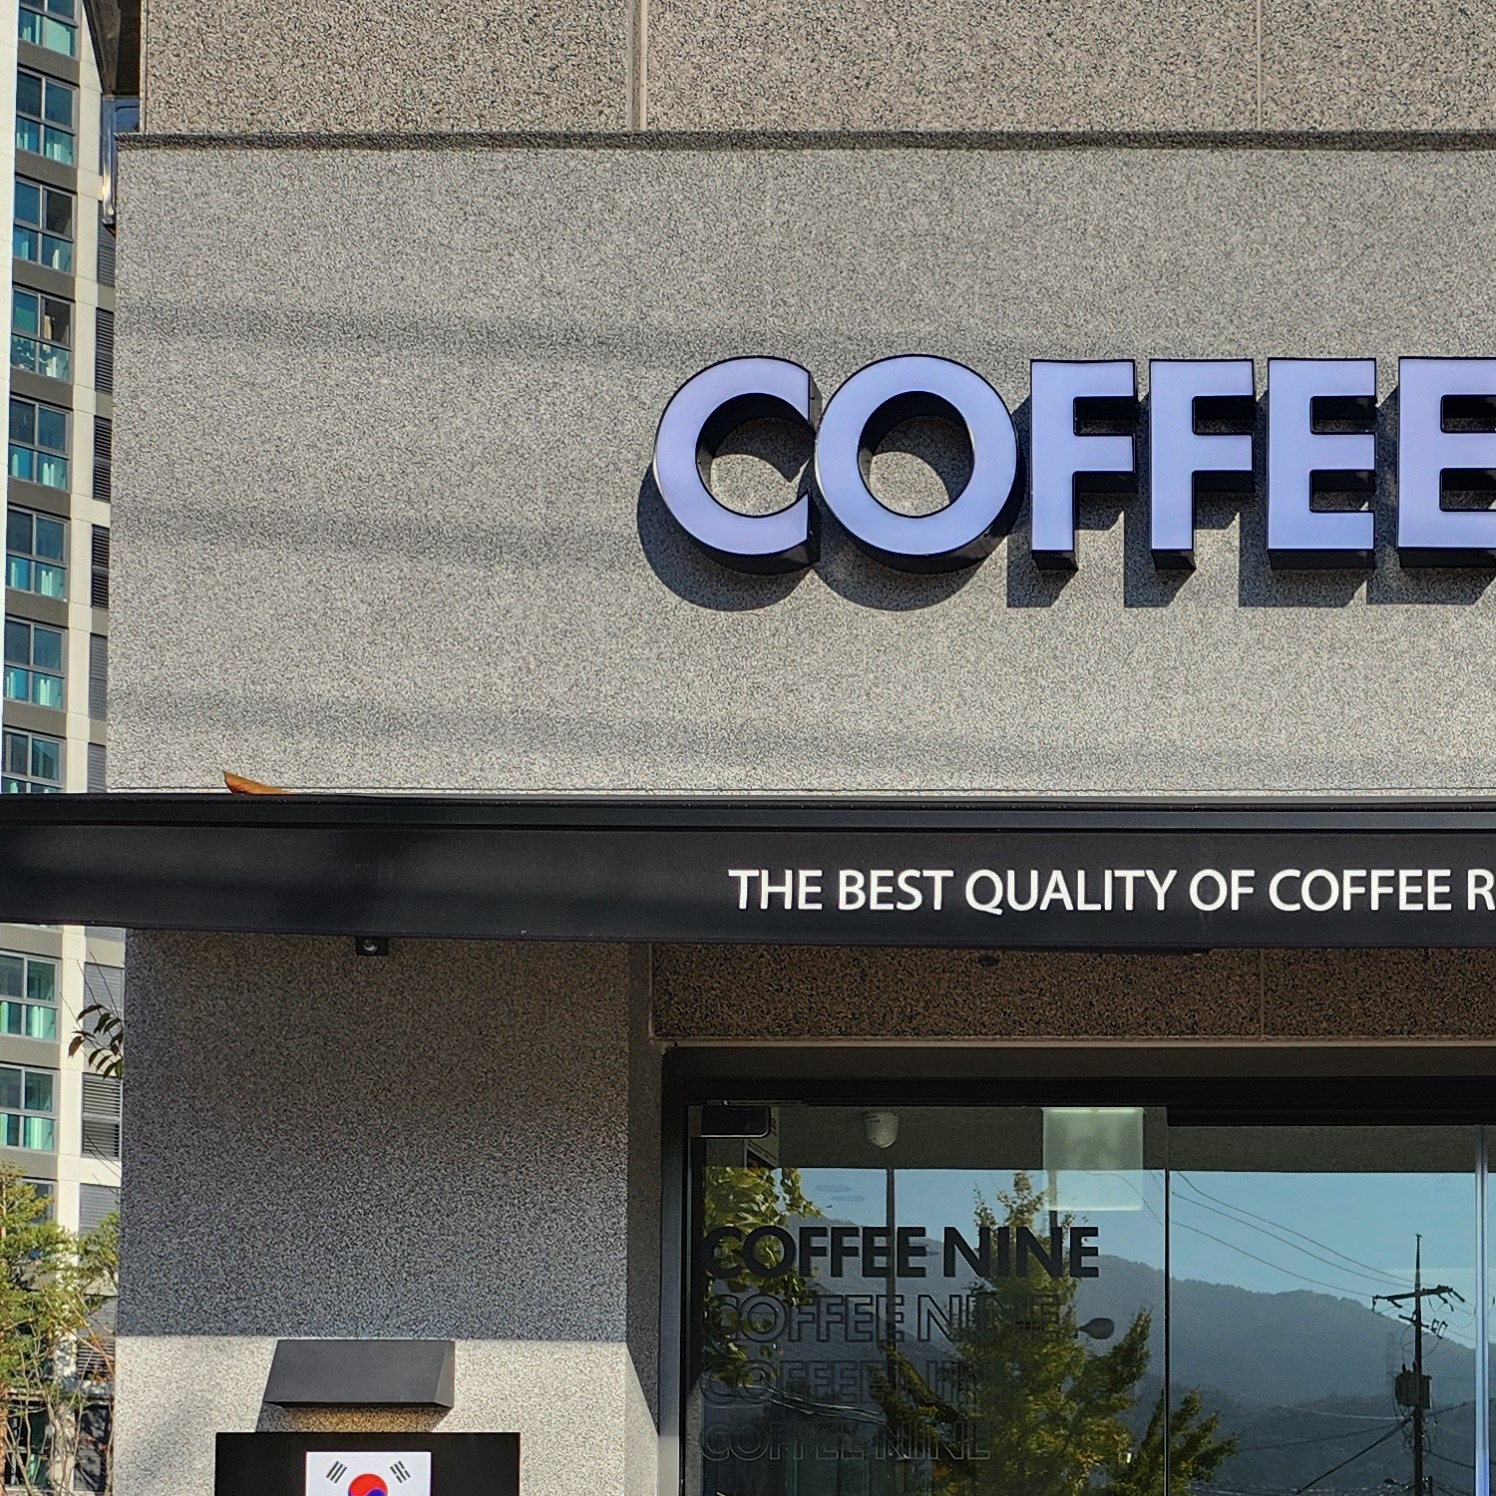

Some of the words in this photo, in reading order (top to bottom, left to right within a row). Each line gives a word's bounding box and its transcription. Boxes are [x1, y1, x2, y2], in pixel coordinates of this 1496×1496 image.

[728, 869, 822, 909] THE
[839, 869, 953, 910] BEST
[966, 870, 1177, 915] QUALITY
[1190, 869, 1255, 911] OF
[1269, 869, 1451, 911] COFFEE
[701, 1226, 927, 1279] COFFEE
[943, 1226, 1099, 1278] NINE
[701, 1293, 906, 1342] COFFEE
